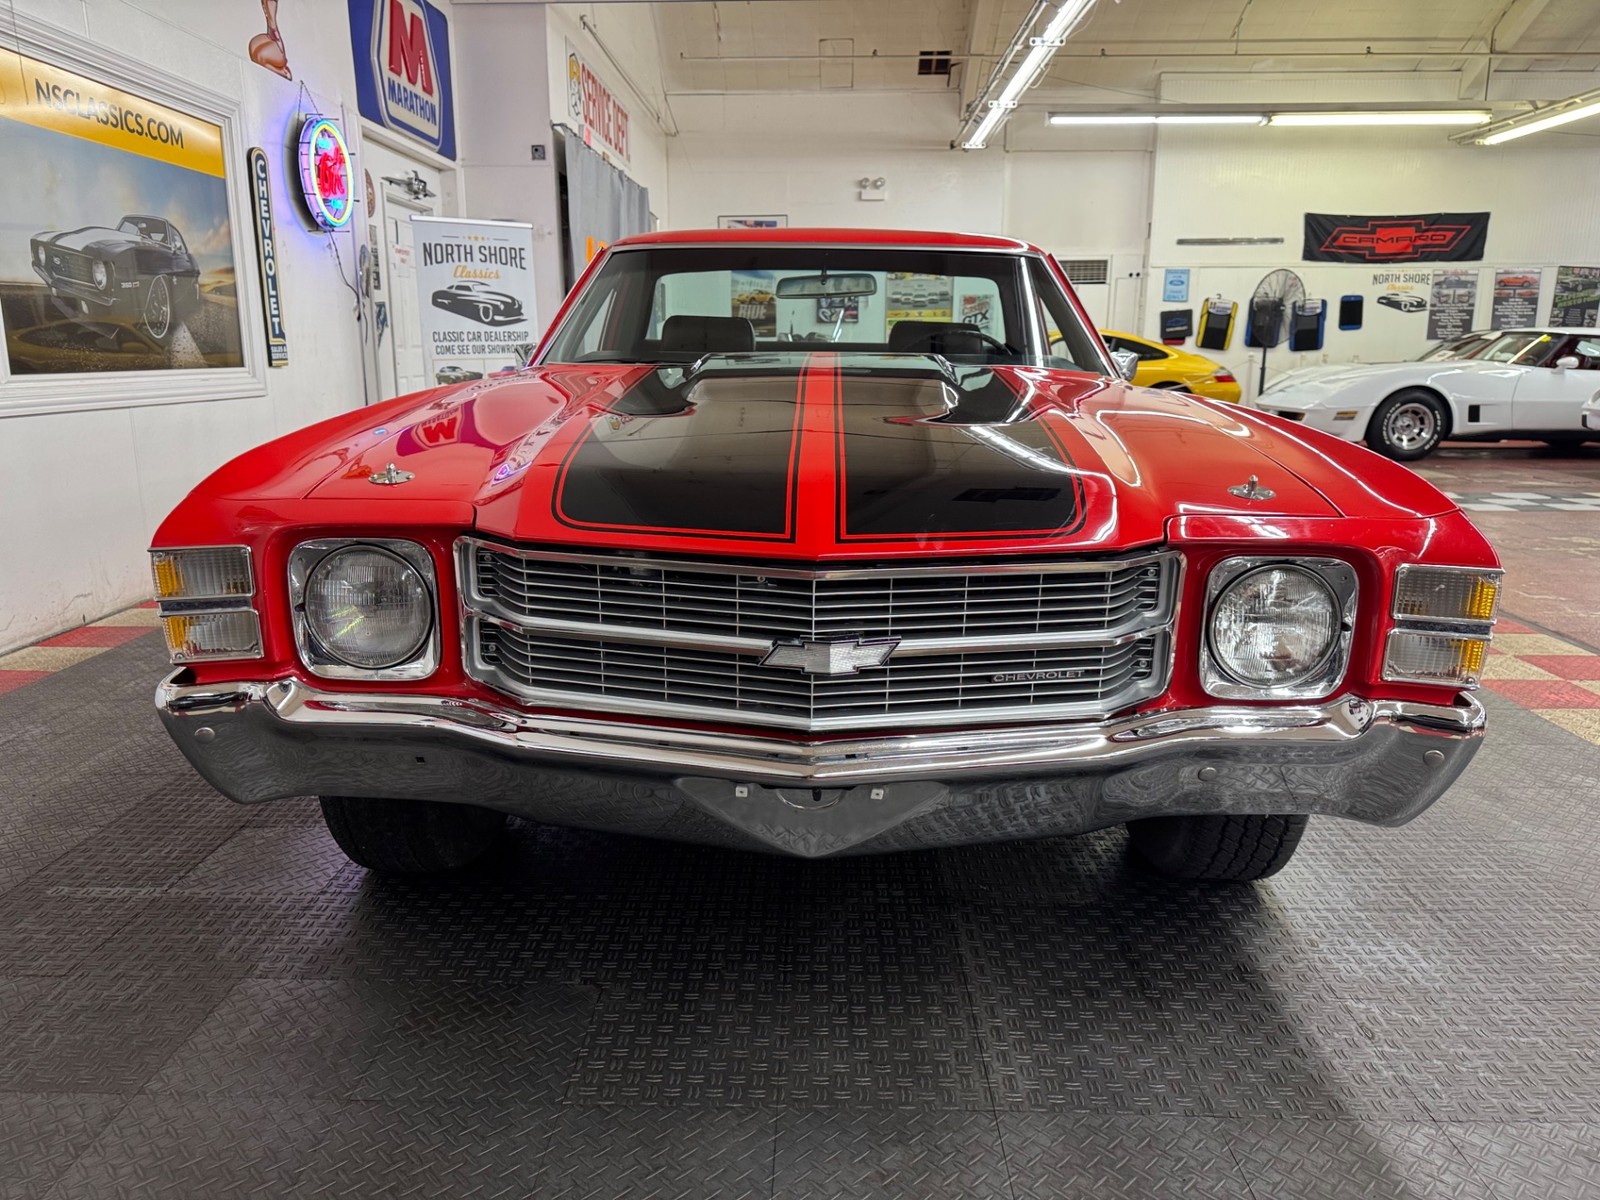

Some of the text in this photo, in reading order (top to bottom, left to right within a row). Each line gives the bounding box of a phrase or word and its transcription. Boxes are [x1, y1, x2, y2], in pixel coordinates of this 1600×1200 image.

[388, 0, 434, 97] M
[387, 77, 437, 126] MARATHON
[582, 63, 611, 146] SERVICE
[35, 78, 184, 149] NSCLASSICS.COM
[256, 158, 280, 334] CHEVROLET
[1342, 234, 1447, 244] CAMARO
[422, 242, 474, 267] NORTH
[478, 245, 527, 270] SHORE
[453, 264, 501, 280] Classics
[1372, 273, 1431, 286] NORTH SHORE
[738, 304, 768, 320] RIDE
[432, 331, 529, 343] CLASSIC CAR DEALERSHIP
[435, 344, 456, 355] COME
[457, 344, 471, 355] SEE
[472, 344, 487, 355] OUR
[993, 670, 1085, 682] CHEVROLET
